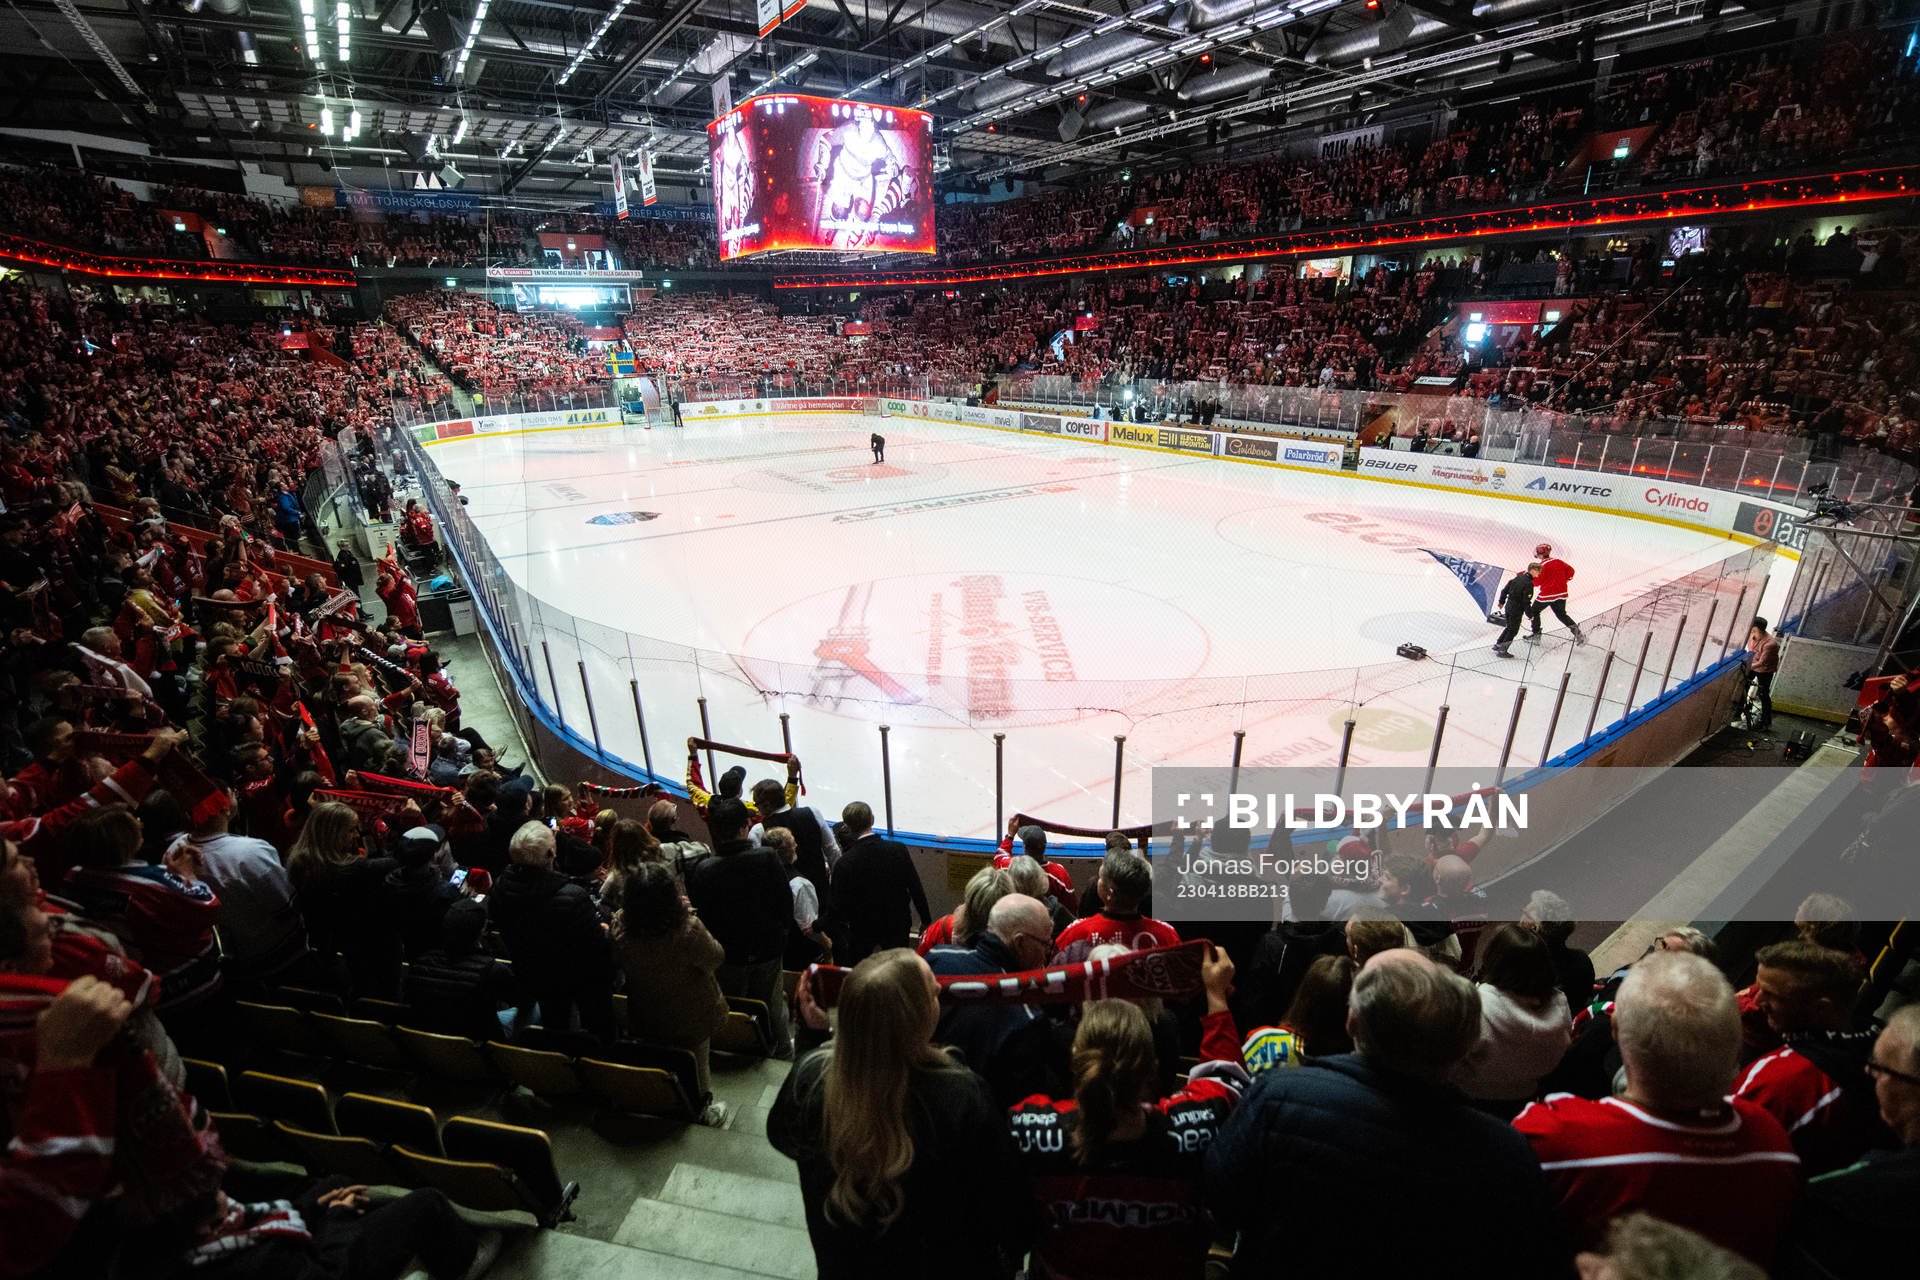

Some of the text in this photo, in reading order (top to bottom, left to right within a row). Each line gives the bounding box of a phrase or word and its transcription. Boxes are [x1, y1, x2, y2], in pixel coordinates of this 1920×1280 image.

[887, 400, 906, 412] coop
[1113, 426, 1153, 443] Malux
[1286, 447, 1325, 463] Polarbröd
[1549, 481, 1613, 498] ANYTEC
[1644, 487, 1710, 514] Cylinda
